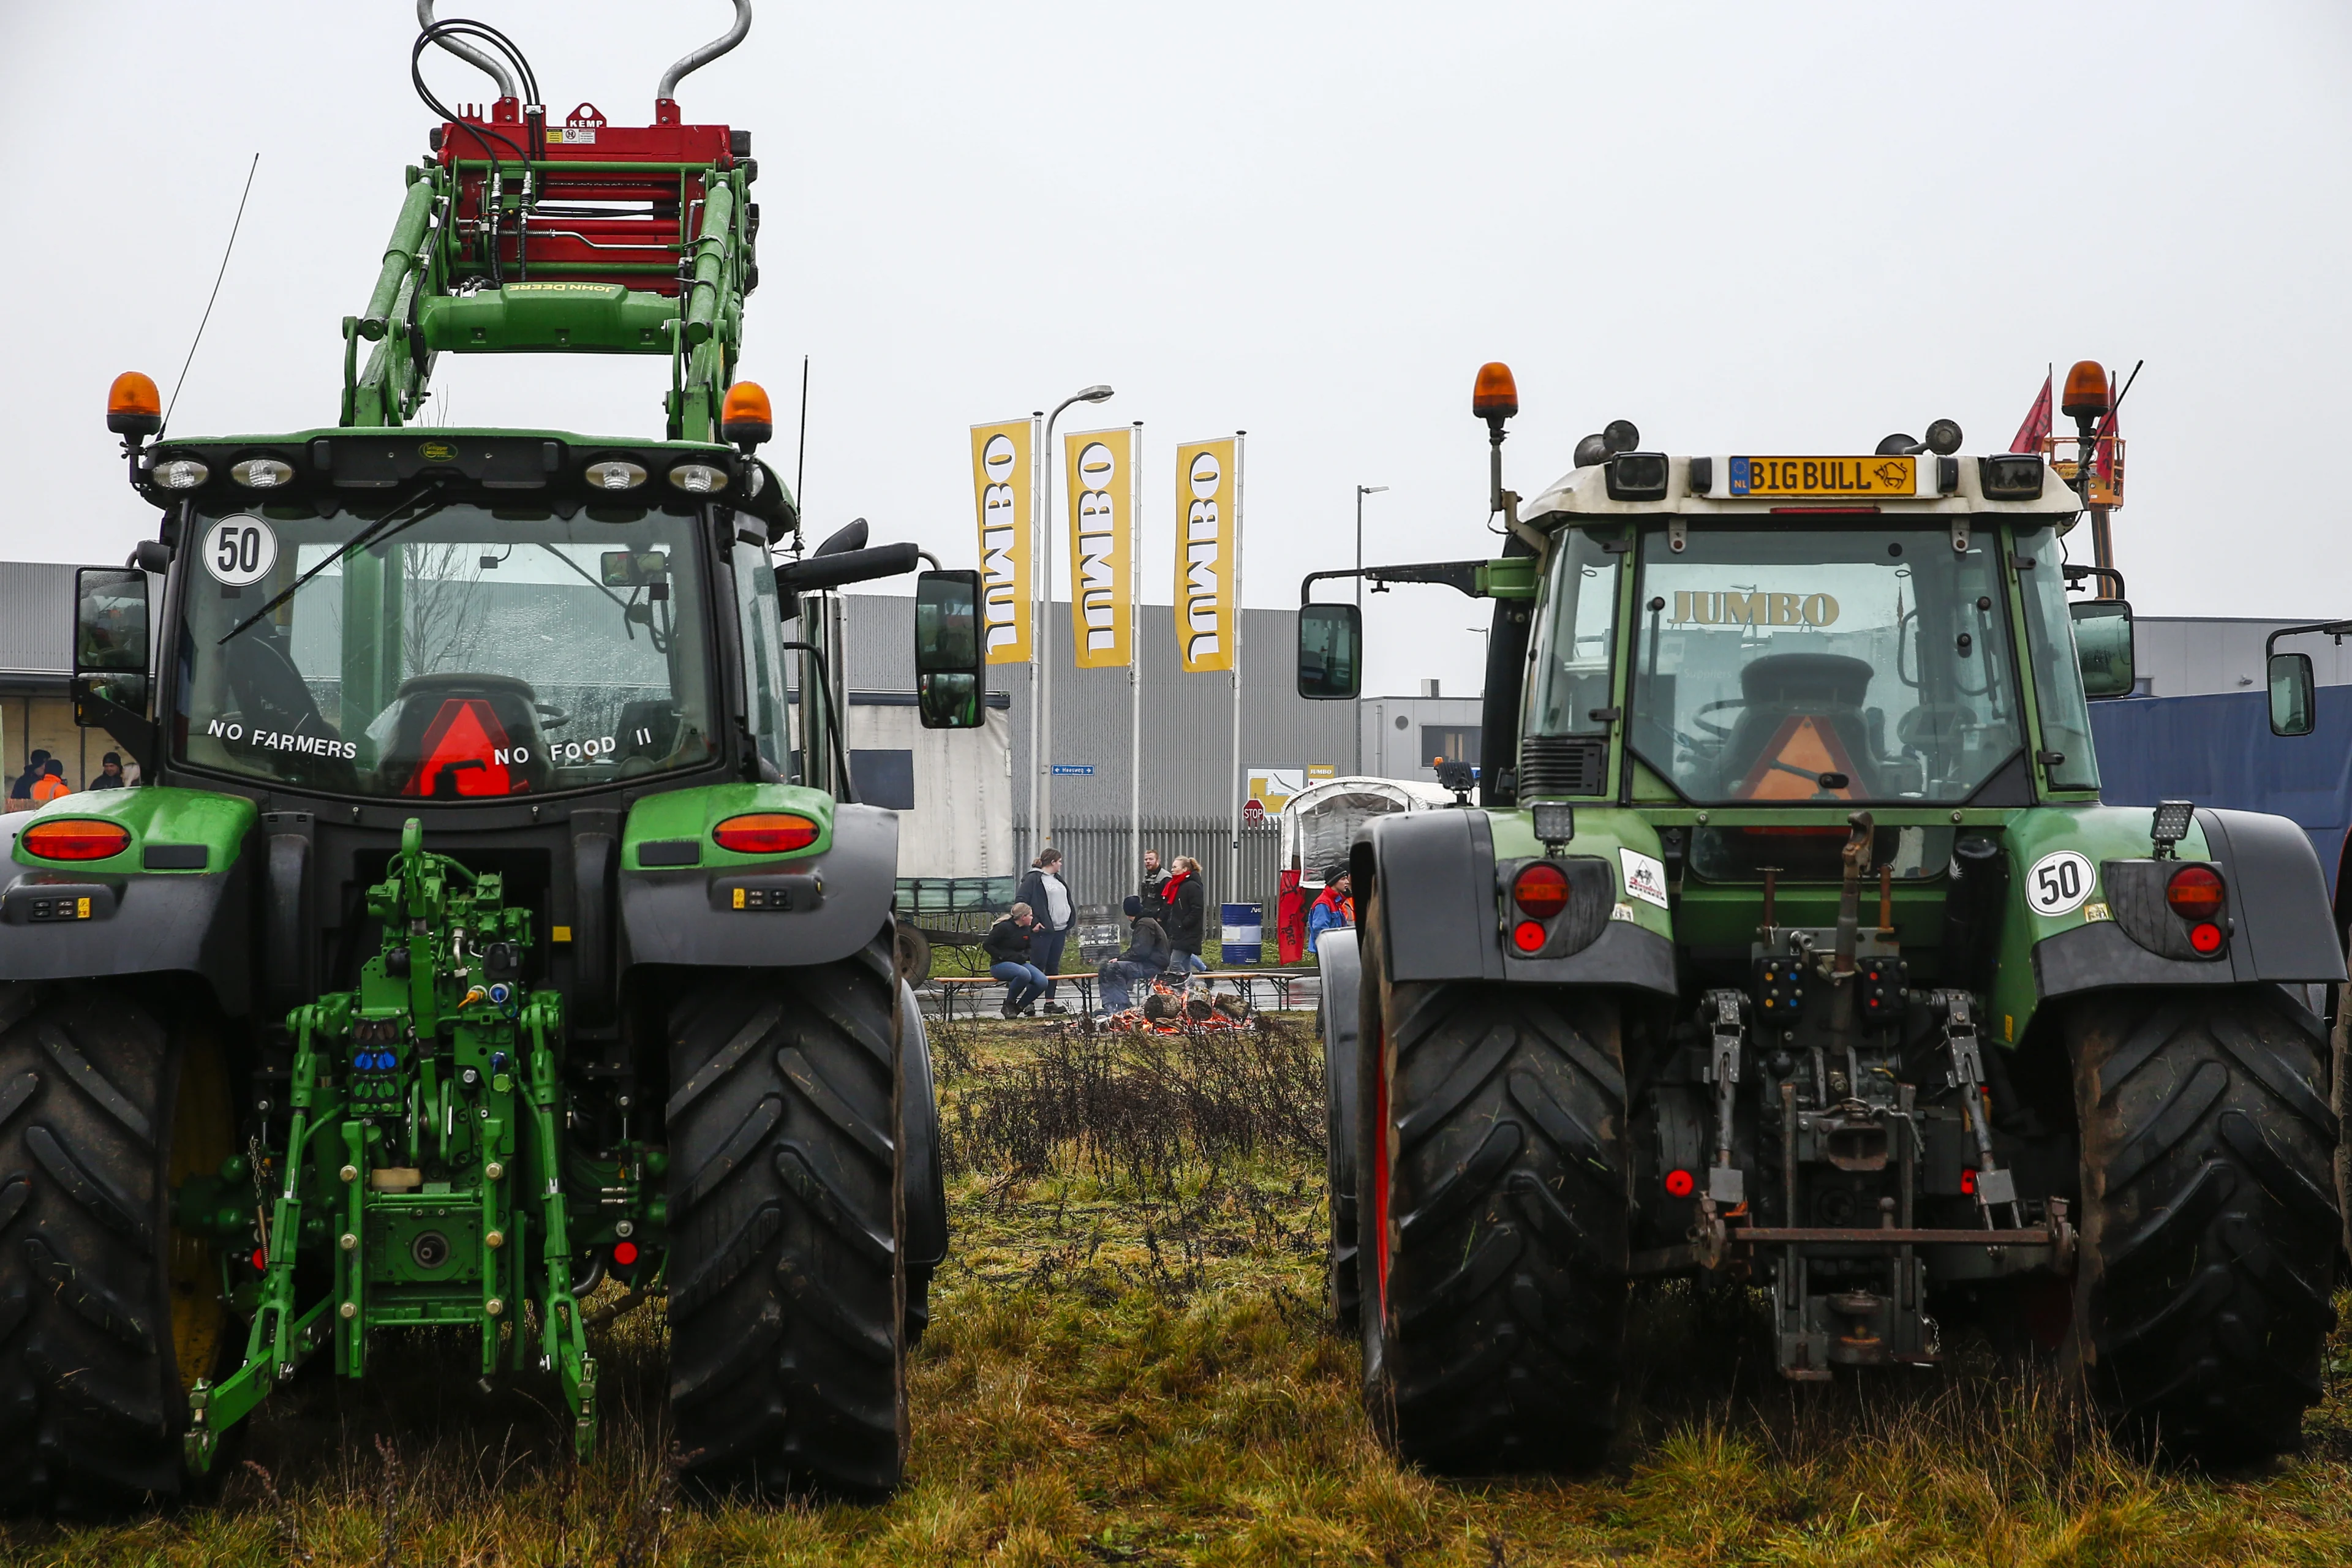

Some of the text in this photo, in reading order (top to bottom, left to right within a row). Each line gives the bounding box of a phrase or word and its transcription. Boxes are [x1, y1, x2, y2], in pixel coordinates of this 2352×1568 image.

[569, 284, 616, 293] JOHN
[1734, 480, 1747, 489] NL
[218, 527, 260, 573] 50
[982, 433, 1017, 656] JUMBO
[1077, 441, 1115, 660] JUMBO
[1186, 451, 1221, 664] JUMBO
[1667, 590, 1840, 627] JUMBO
[207, 719, 357, 760] NO FARMERS
[494, 747, 530, 766] NO
[550, 736, 616, 761] FOOD
[1244, 809, 1263, 820] STOP
[2038, 861, 2081, 905] 50
